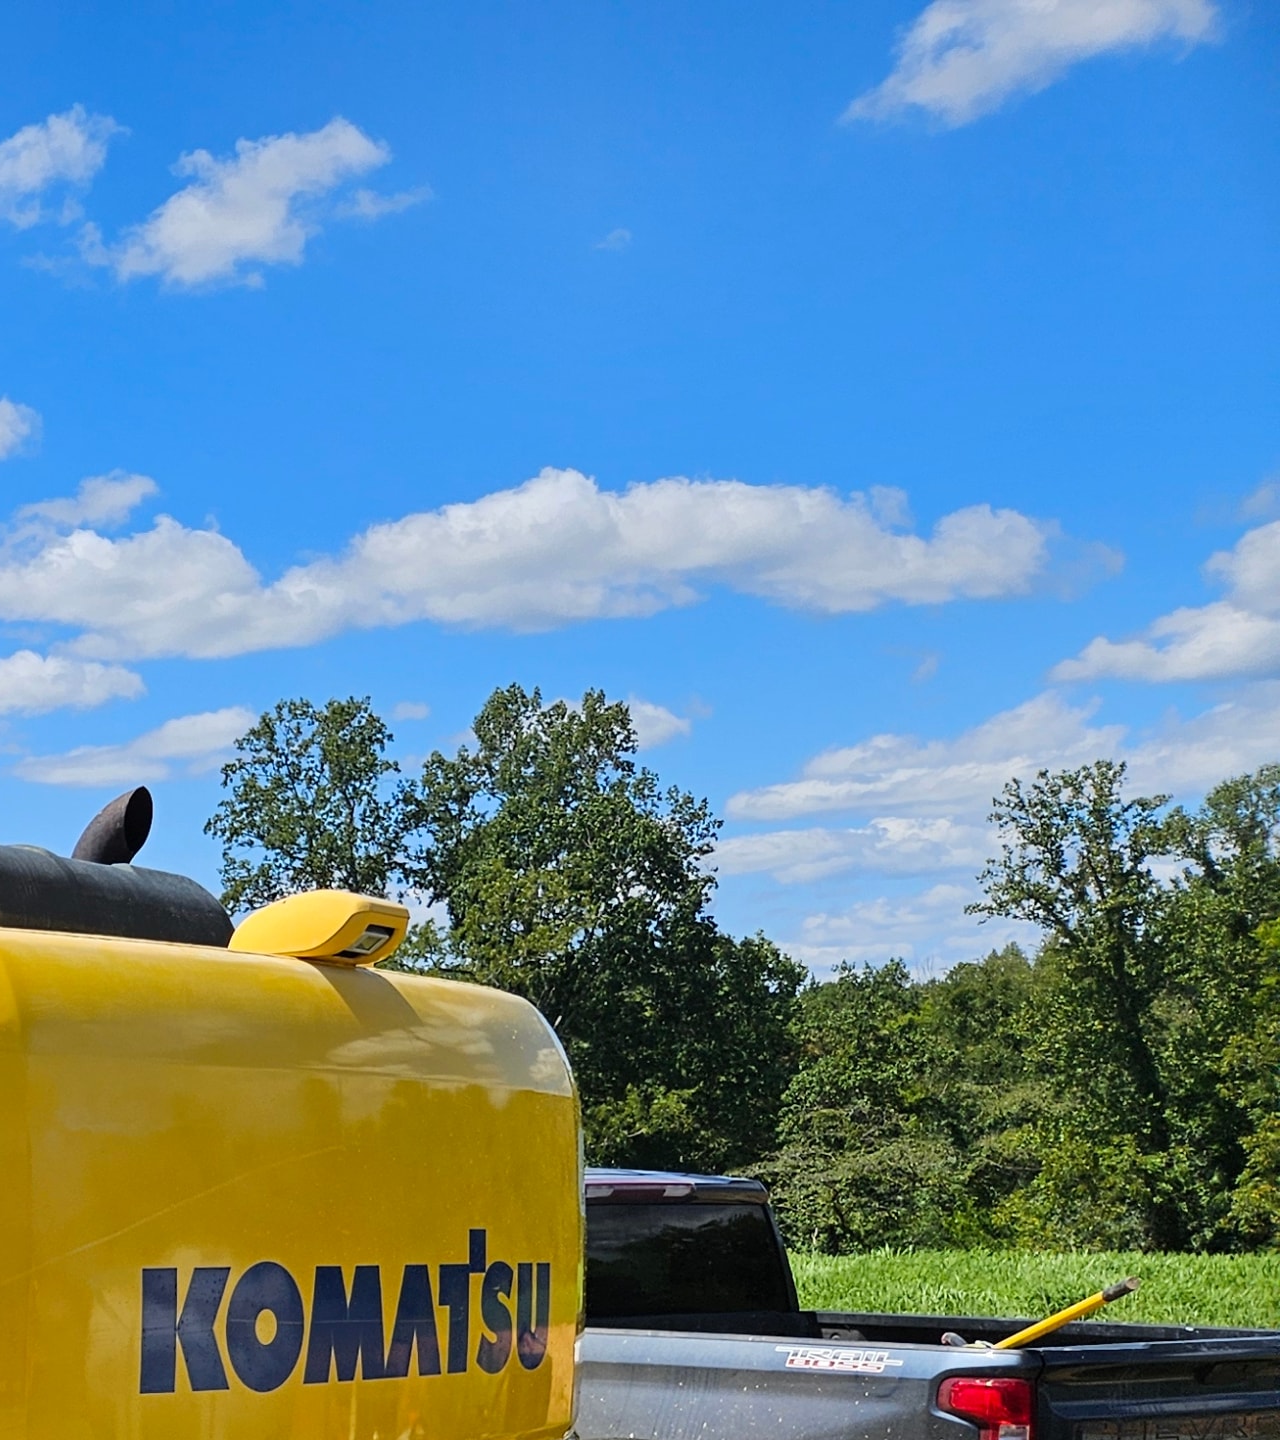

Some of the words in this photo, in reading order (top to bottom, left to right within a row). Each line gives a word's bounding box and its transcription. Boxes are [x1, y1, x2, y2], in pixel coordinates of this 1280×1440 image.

[140, 1229, 550, 1394] KOMATSU
[775, 1346, 903, 1367] TRAIL
[785, 1358, 885, 1373] BOSS
